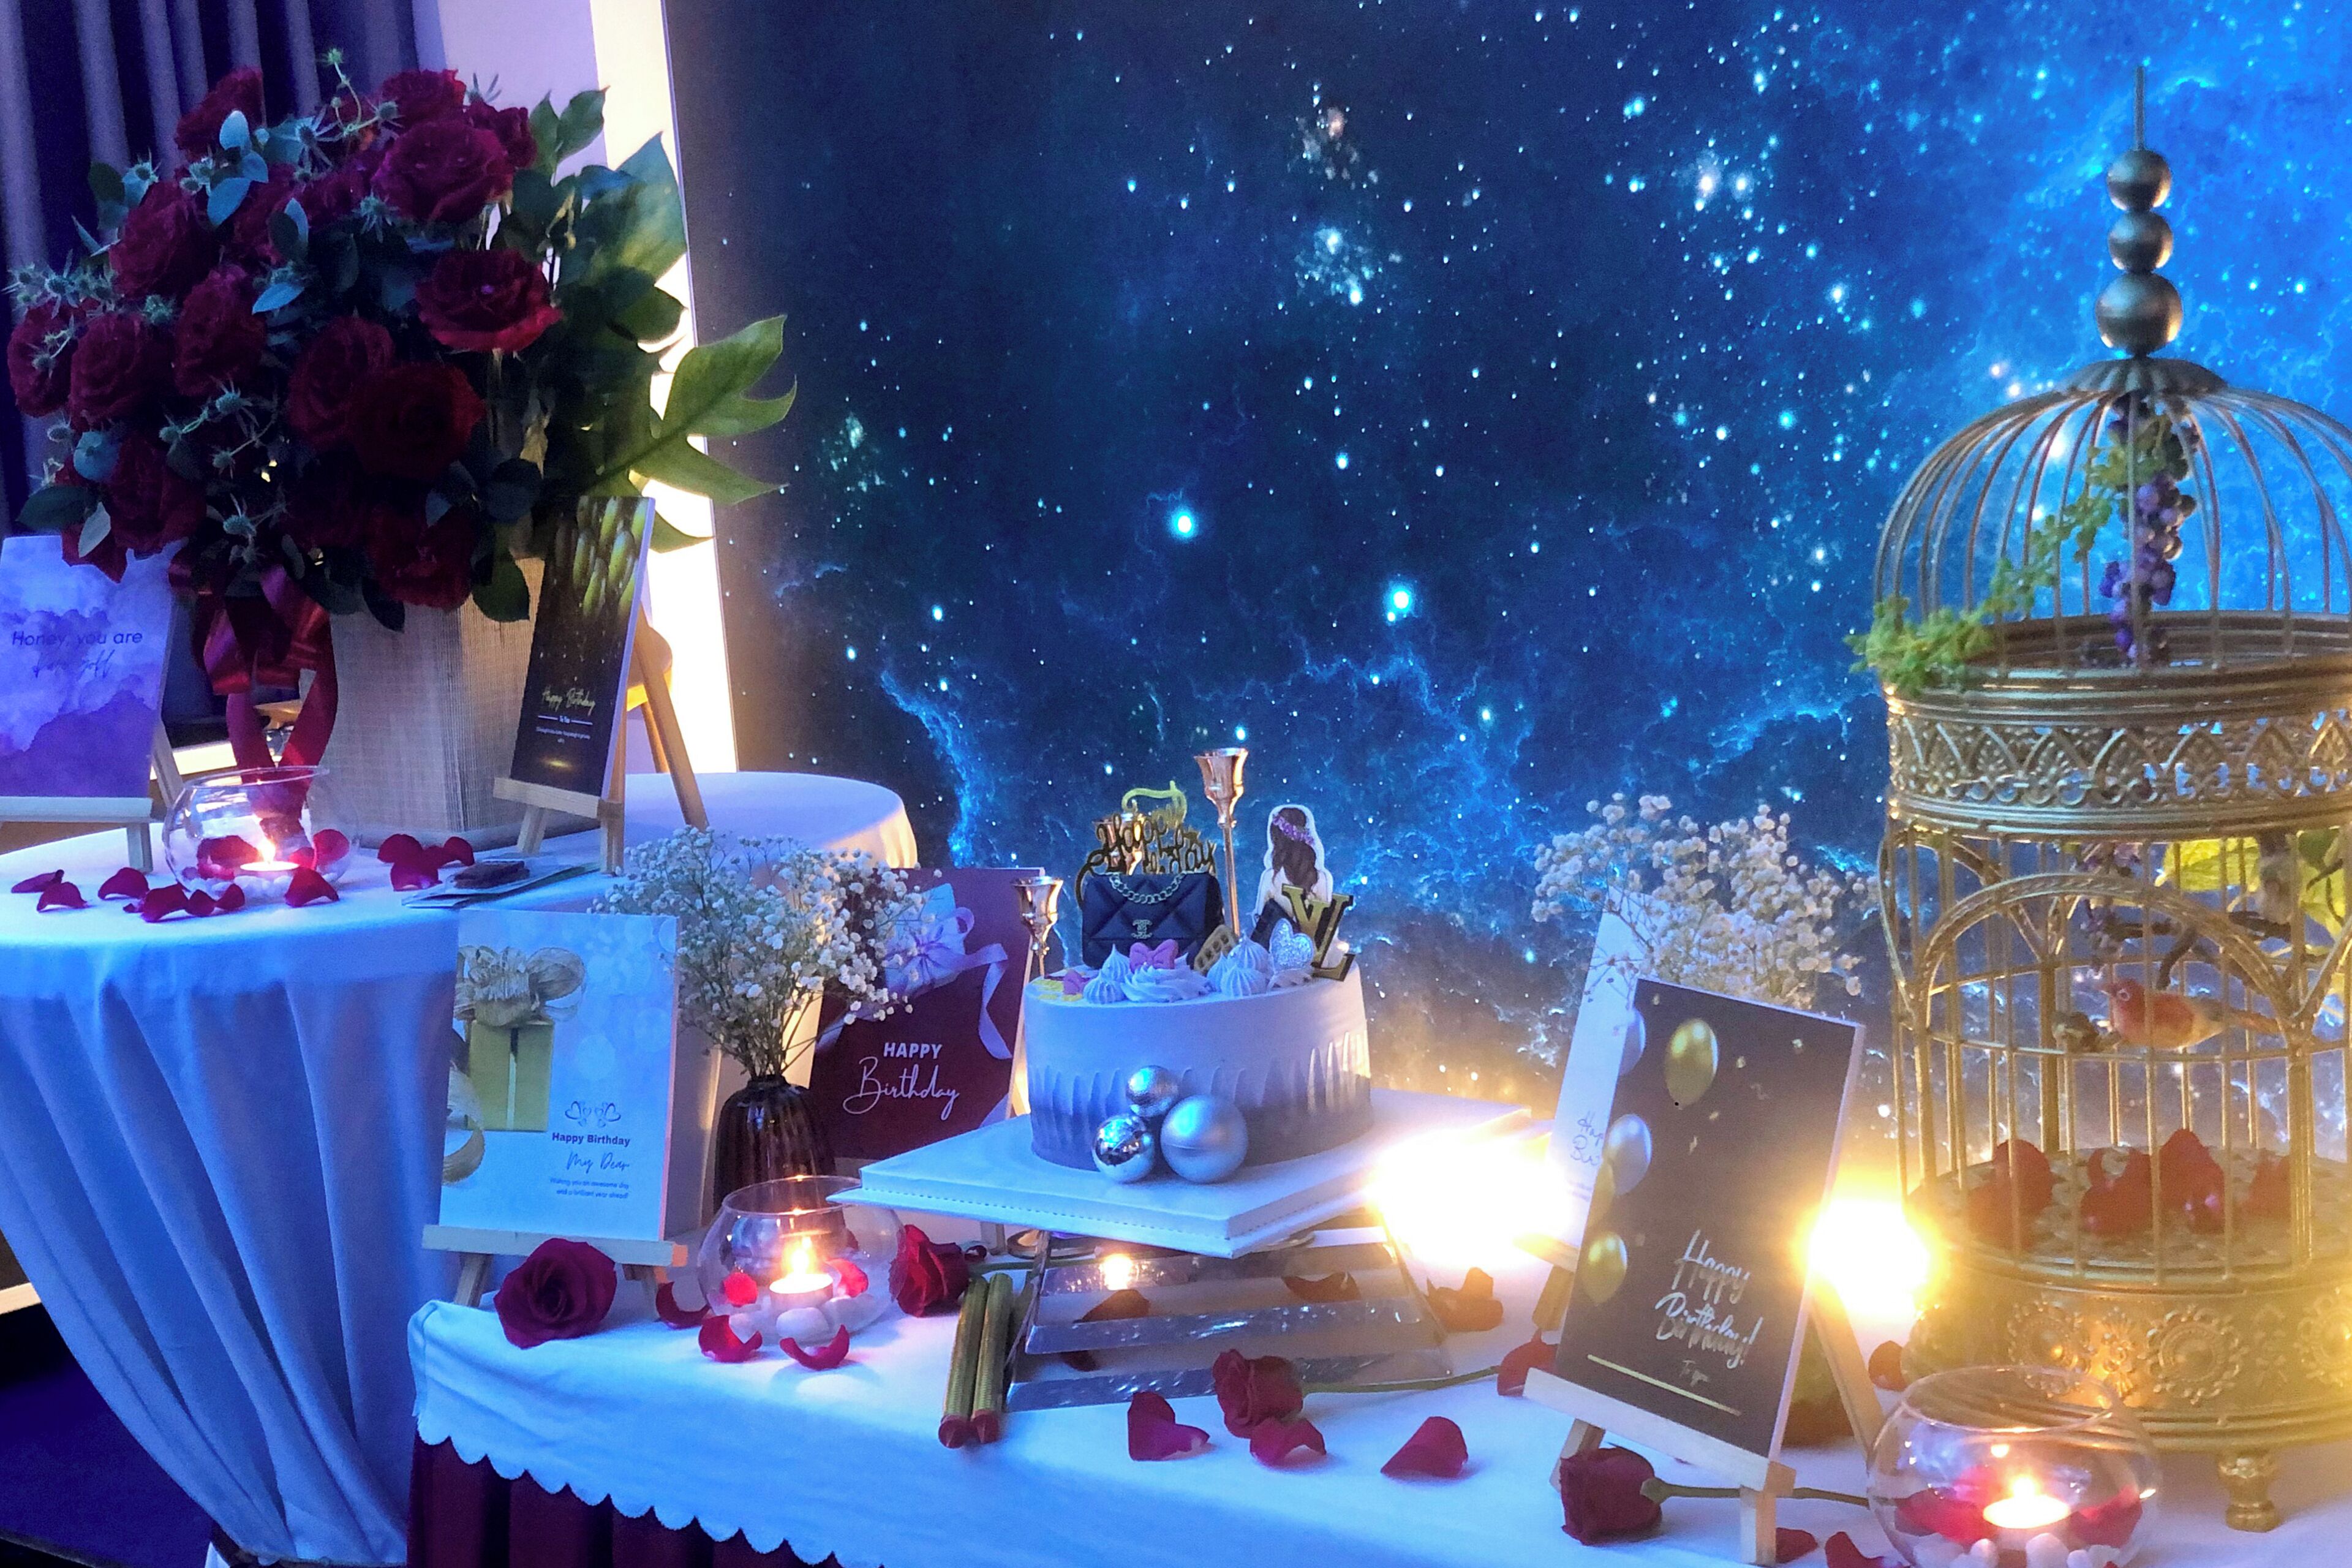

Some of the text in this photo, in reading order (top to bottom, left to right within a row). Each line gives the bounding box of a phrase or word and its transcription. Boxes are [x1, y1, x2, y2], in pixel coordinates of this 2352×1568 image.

[77, 633, 107, 650] you
[113, 632, 143, 644] are
[883, 1042, 943, 1059] HAPPY
[842, 1056, 960, 1121] Birthday
[552, 1133, 630, 1147] Happy Birthday
[567, 1151, 630, 1174] My Dear
[1672, 1229, 1751, 1304] Happy
[1655, 1292, 1763, 1369] Birthday!
